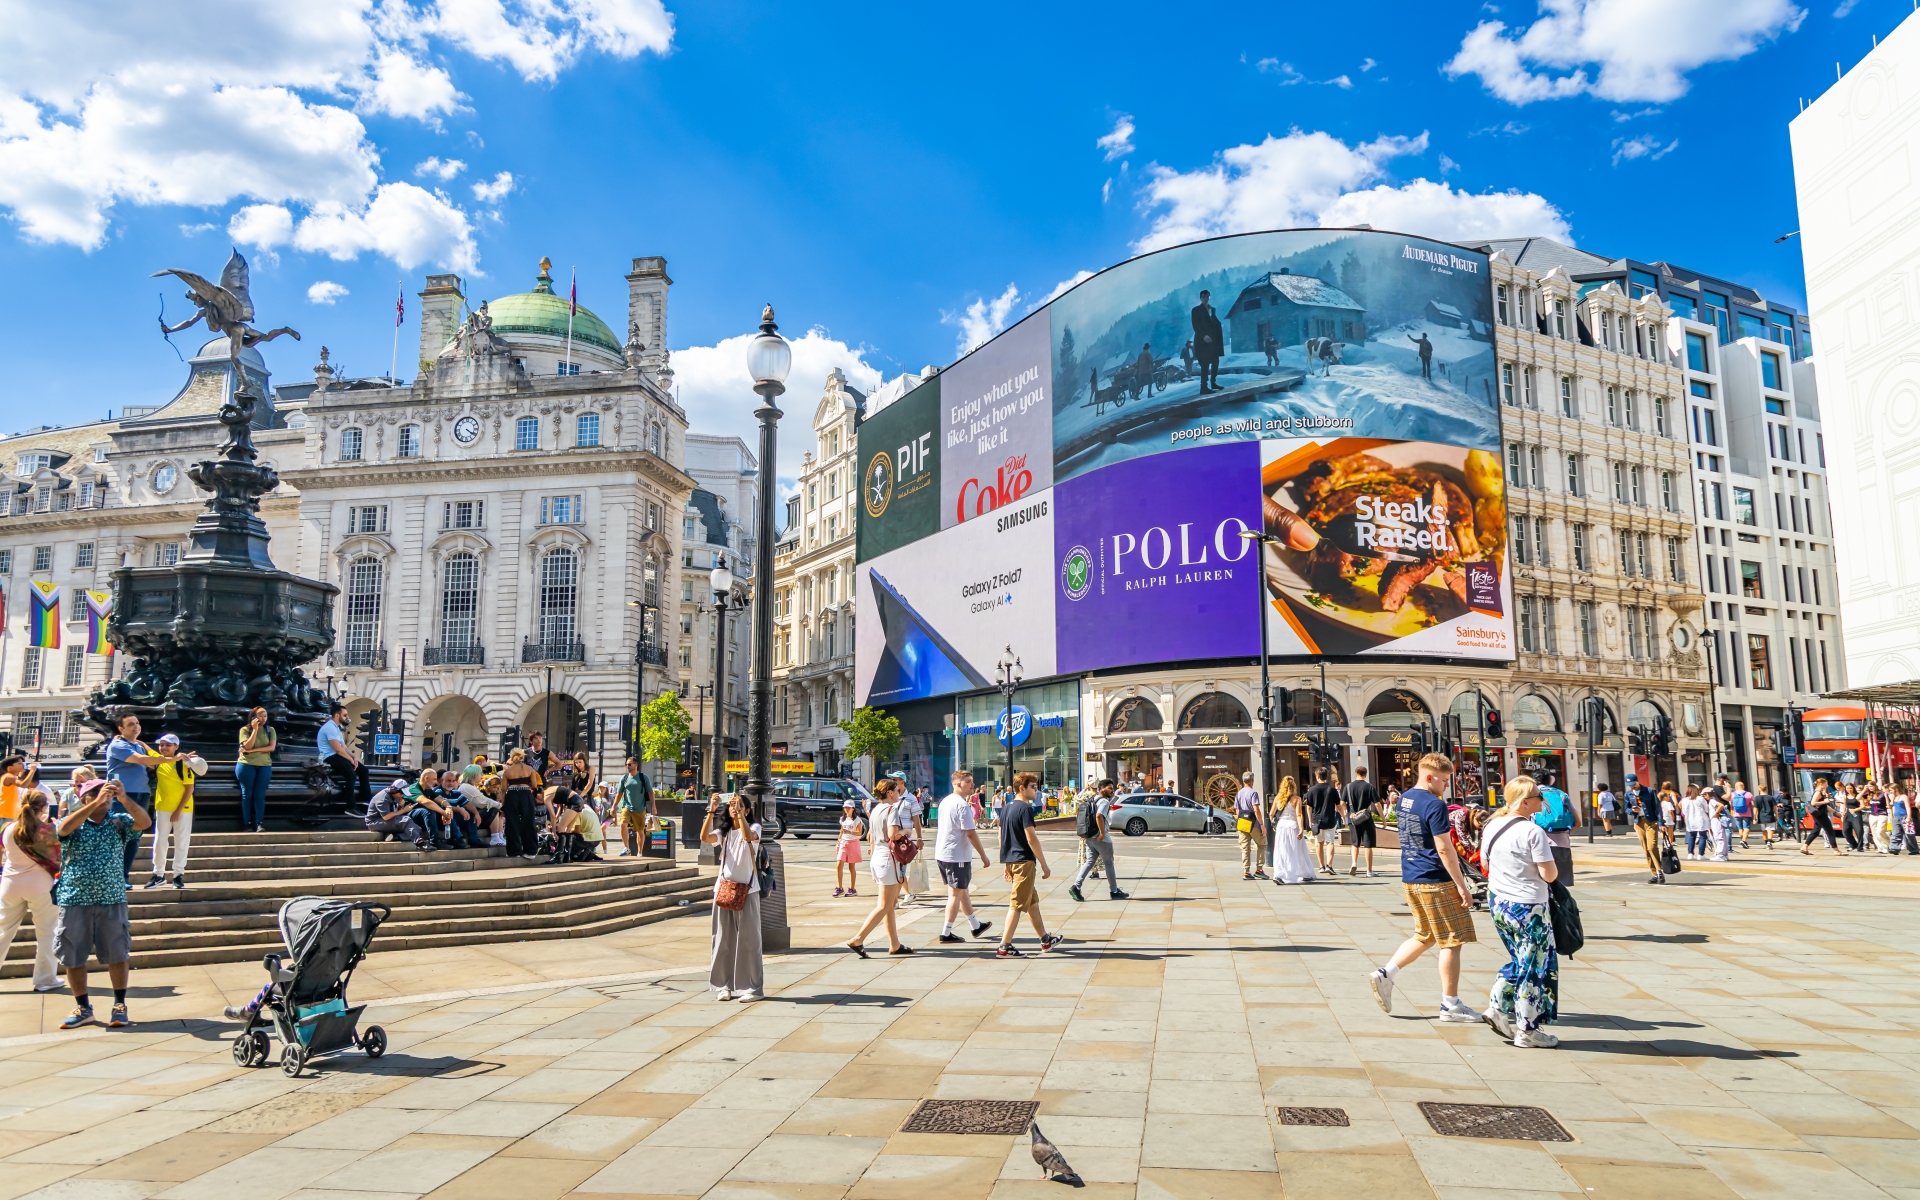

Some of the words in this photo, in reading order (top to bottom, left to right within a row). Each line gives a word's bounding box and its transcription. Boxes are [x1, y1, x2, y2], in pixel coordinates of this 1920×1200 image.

[1402, 245, 1448, 266] AUDEMARS
[1450, 254, 1478, 273] PIGUET
[951, 398, 980, 424] Enjoy
[983, 378, 1012, 406] what
[1015, 365, 1039, 393] you
[947, 429, 967, 448] like,
[969, 413, 990, 442] just
[993, 400, 1017, 425] how
[1020, 387, 1044, 415] you
[1171, 425, 1212, 443] people
[1216, 424, 1232, 434] as
[1235, 418, 1261, 432] wild
[1265, 417, 1291, 429] and
[1295, 415, 1353, 428] stubborn
[978, 434, 998, 455] like
[1000, 426, 1008, 444] it
[897, 431, 931, 482] PIF
[1005, 453, 1027, 474] Diet
[957, 467, 1032, 524] Coke
[997, 501, 1048, 533] SAMSUNG
[1355, 495, 1450, 525] Steaks.
[1112, 517, 1251, 576] POLO
[1354, 521, 1453, 551] Raised.
[962, 579, 991, 598] Galaxy
[992, 575, 998, 589] Z
[999, 567, 1022, 588] Fold7
[1126, 575, 1167, 591] RALPH
[1175, 569, 1233, 584] LAUREN
[971, 599, 995, 613] Galaxy
[997, 595, 1003, 607] AI
[1456, 626, 1506, 642] Sainsbury's
[962, 725, 992, 736] pharmacy
[1039, 715, 1063, 728] beauty
[1197, 734, 1222, 745] Lindt
[1843, 751, 1855, 760] 38
